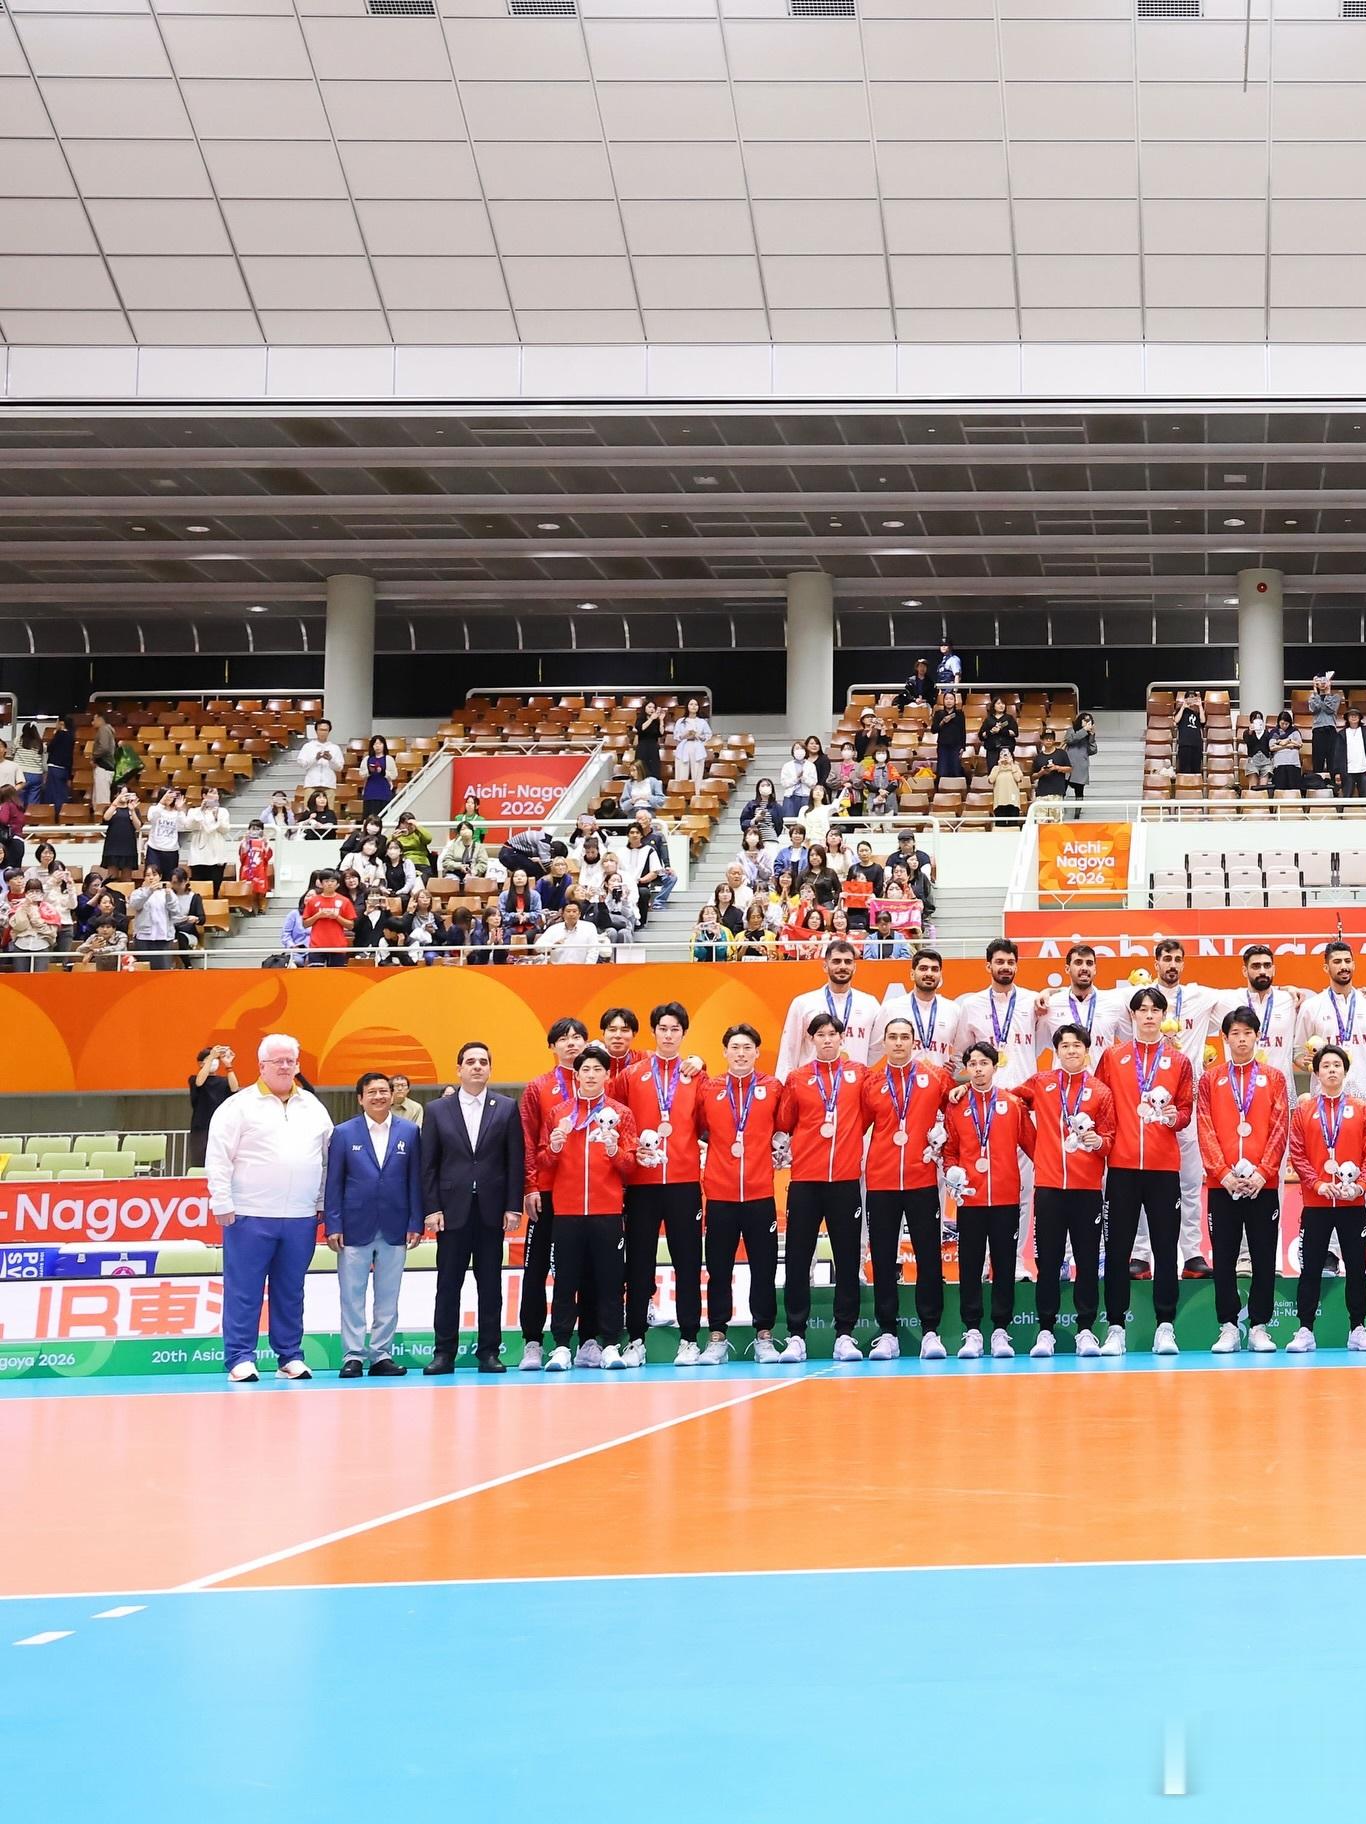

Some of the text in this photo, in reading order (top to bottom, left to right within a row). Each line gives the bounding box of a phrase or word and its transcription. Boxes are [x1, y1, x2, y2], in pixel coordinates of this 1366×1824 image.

[464, 783, 569, 802] Aichi-Nago
[500, 801, 545, 816] 2026
[1063, 840, 1109, 854] Aichi-
[1056, 855, 1115, 871] Nagoya
[1067, 872, 1105, 885] 2026
[912, 1040, 948, 1054] RAN
[39, 1353, 75, 1366] 2026
[152, 1348, 224, 1363] 20th Asia
